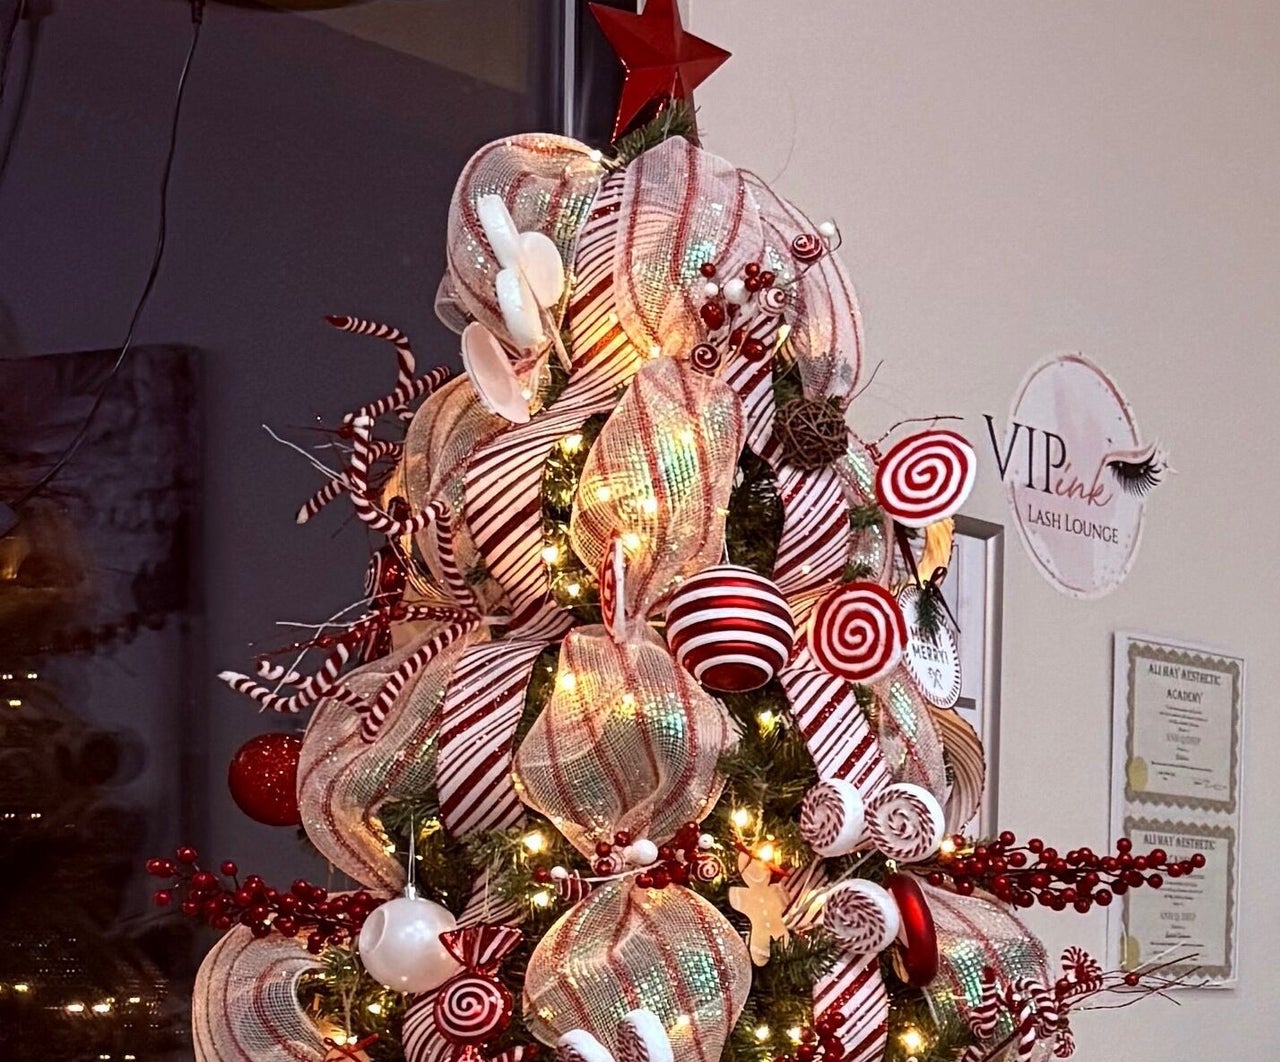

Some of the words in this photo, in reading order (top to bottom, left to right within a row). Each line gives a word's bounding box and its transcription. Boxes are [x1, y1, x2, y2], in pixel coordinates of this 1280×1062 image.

[983, 414, 1113, 507] VIPink
[1027, 505, 1061, 530] LASH
[1065, 514, 1119, 543] LOUNGE
